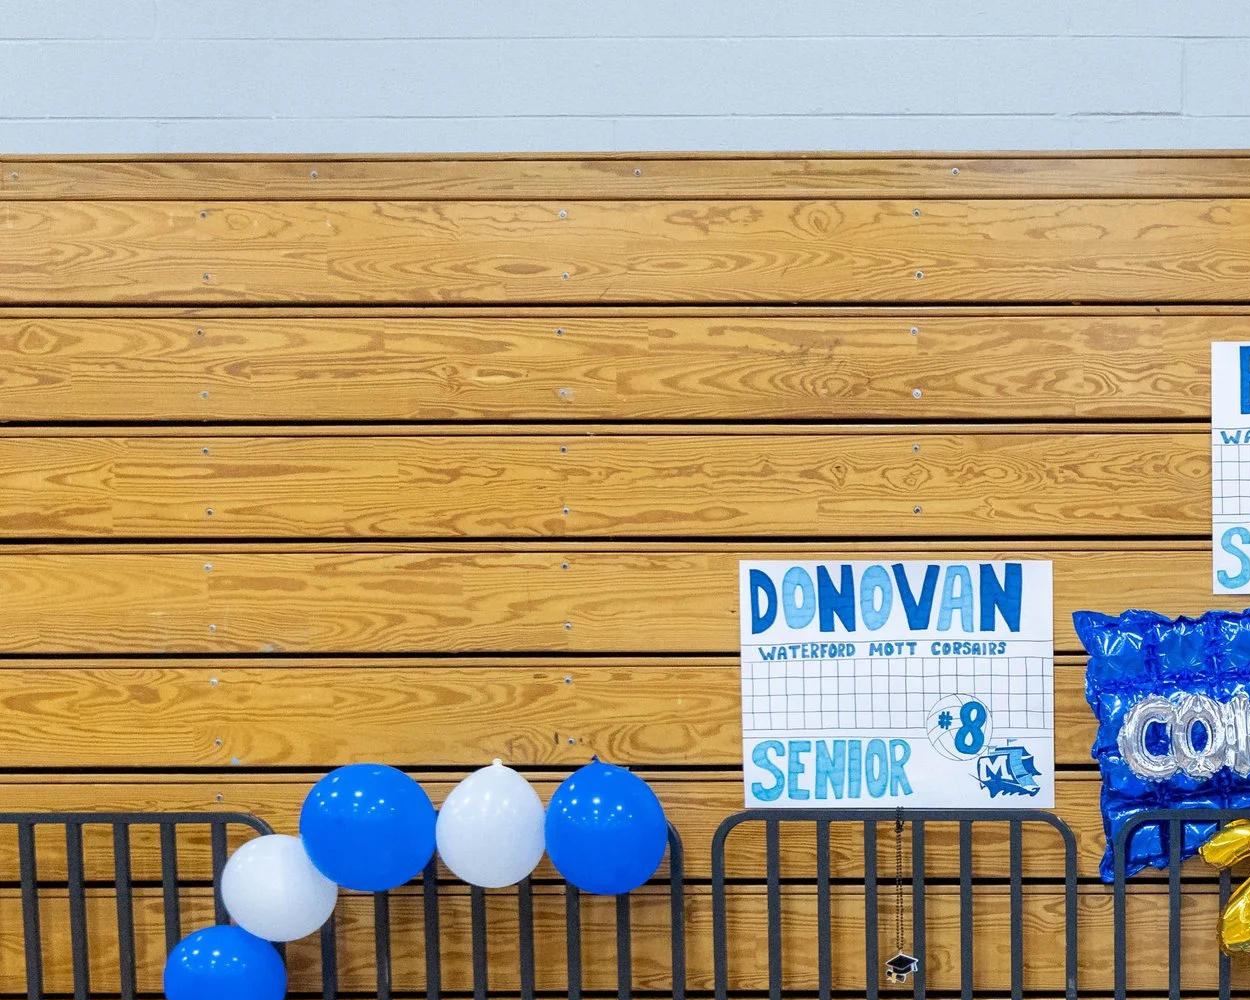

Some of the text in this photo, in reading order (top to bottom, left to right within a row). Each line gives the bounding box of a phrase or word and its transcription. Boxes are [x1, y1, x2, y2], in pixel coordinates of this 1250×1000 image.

[749, 563, 1022, 634] DONOVAN
[758, 641, 1007, 661] WATERFORD MOTT CORSAIRS
[938, 701, 987, 755] #8
[751, 738, 914, 802] SENIOR
